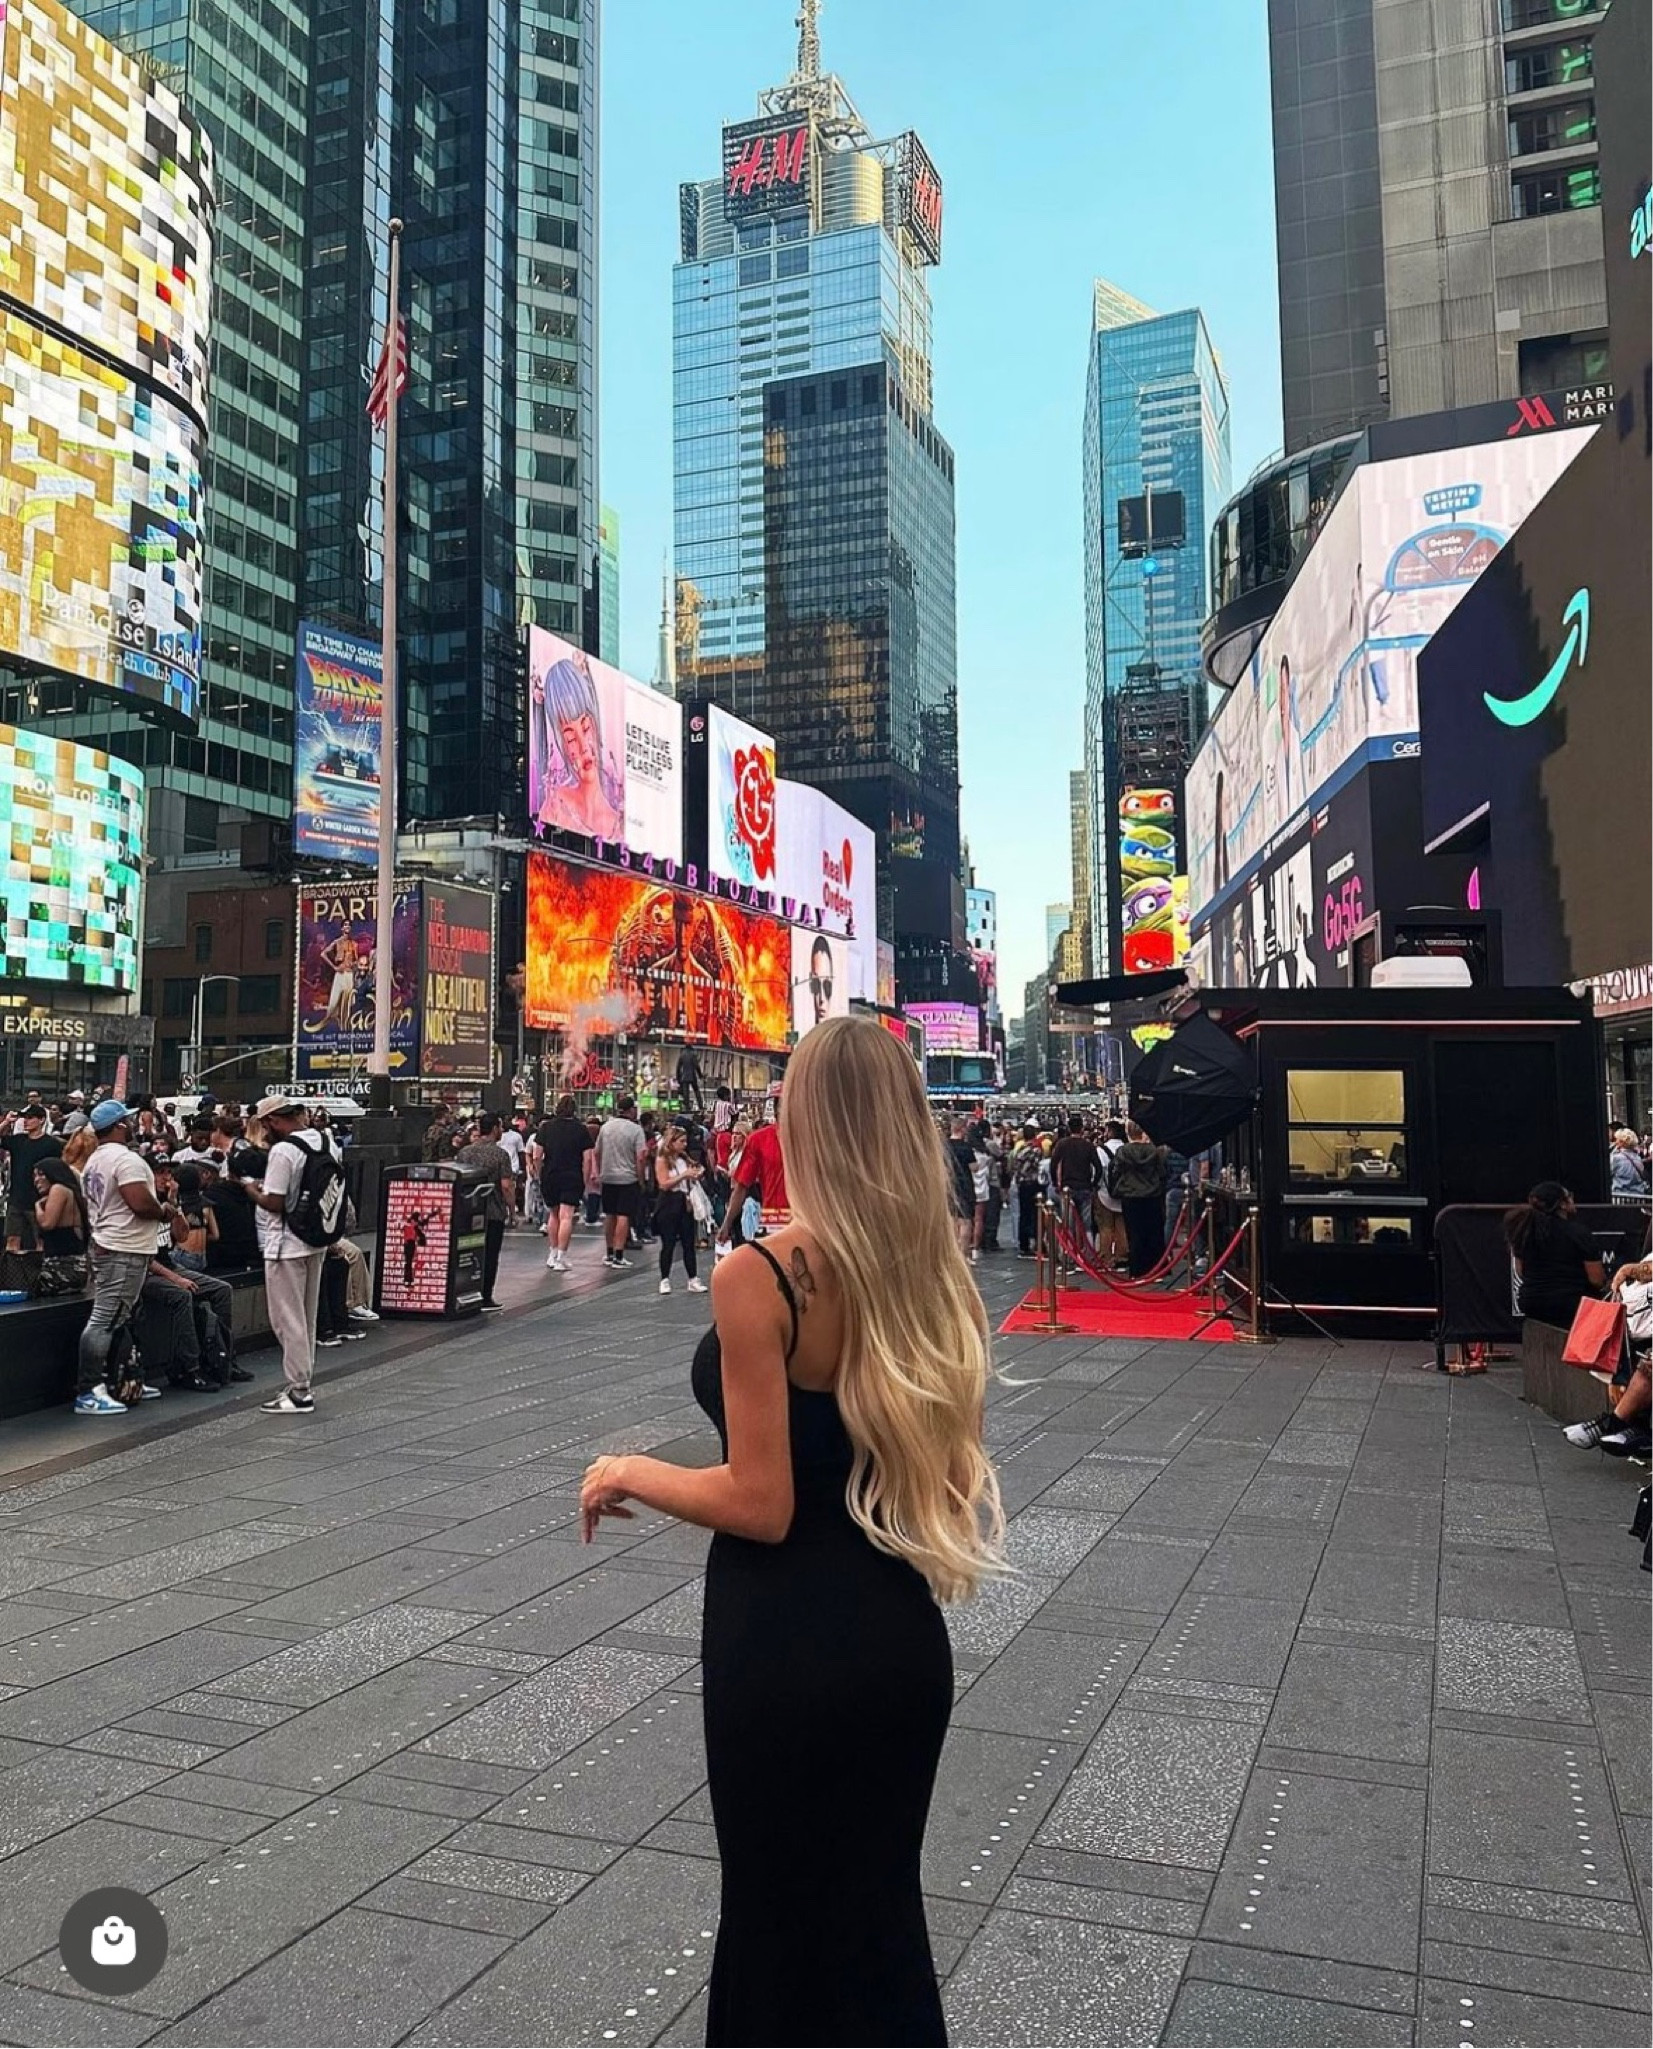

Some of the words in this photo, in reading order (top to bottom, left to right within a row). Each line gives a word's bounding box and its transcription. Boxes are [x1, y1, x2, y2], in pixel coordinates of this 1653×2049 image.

[41, 581, 145, 646] Paradise
[153, 625, 199, 677] Island
[306, 640, 353, 661] BROADWAY
[323, 636, 343, 649] TIME
[345, 643, 356, 653] TO
[143, 660, 173, 685] Club
[651, 735, 670, 755] LIVE
[691, 733, 703, 742] LG
[626, 739, 649, 759] WITH
[651, 749, 672, 770] LESS
[626, 754, 662, 781] PLASTIC
[823, 851, 843, 884] Real
[303, 884, 370, 899] BROADWAY'S
[593, 836, 675, 881] 1540
[686, 864, 825, 927] BROADWAY
[429, 897, 445, 923] THE
[426, 973, 434, 1008] A
[436, 974, 488, 1013] BEAUTIFUL
[4, 1015, 85, 1036] EXPRESS
[425, 1009, 456, 1045] NOISE
[265, 1083, 307, 1097] GIFTS
